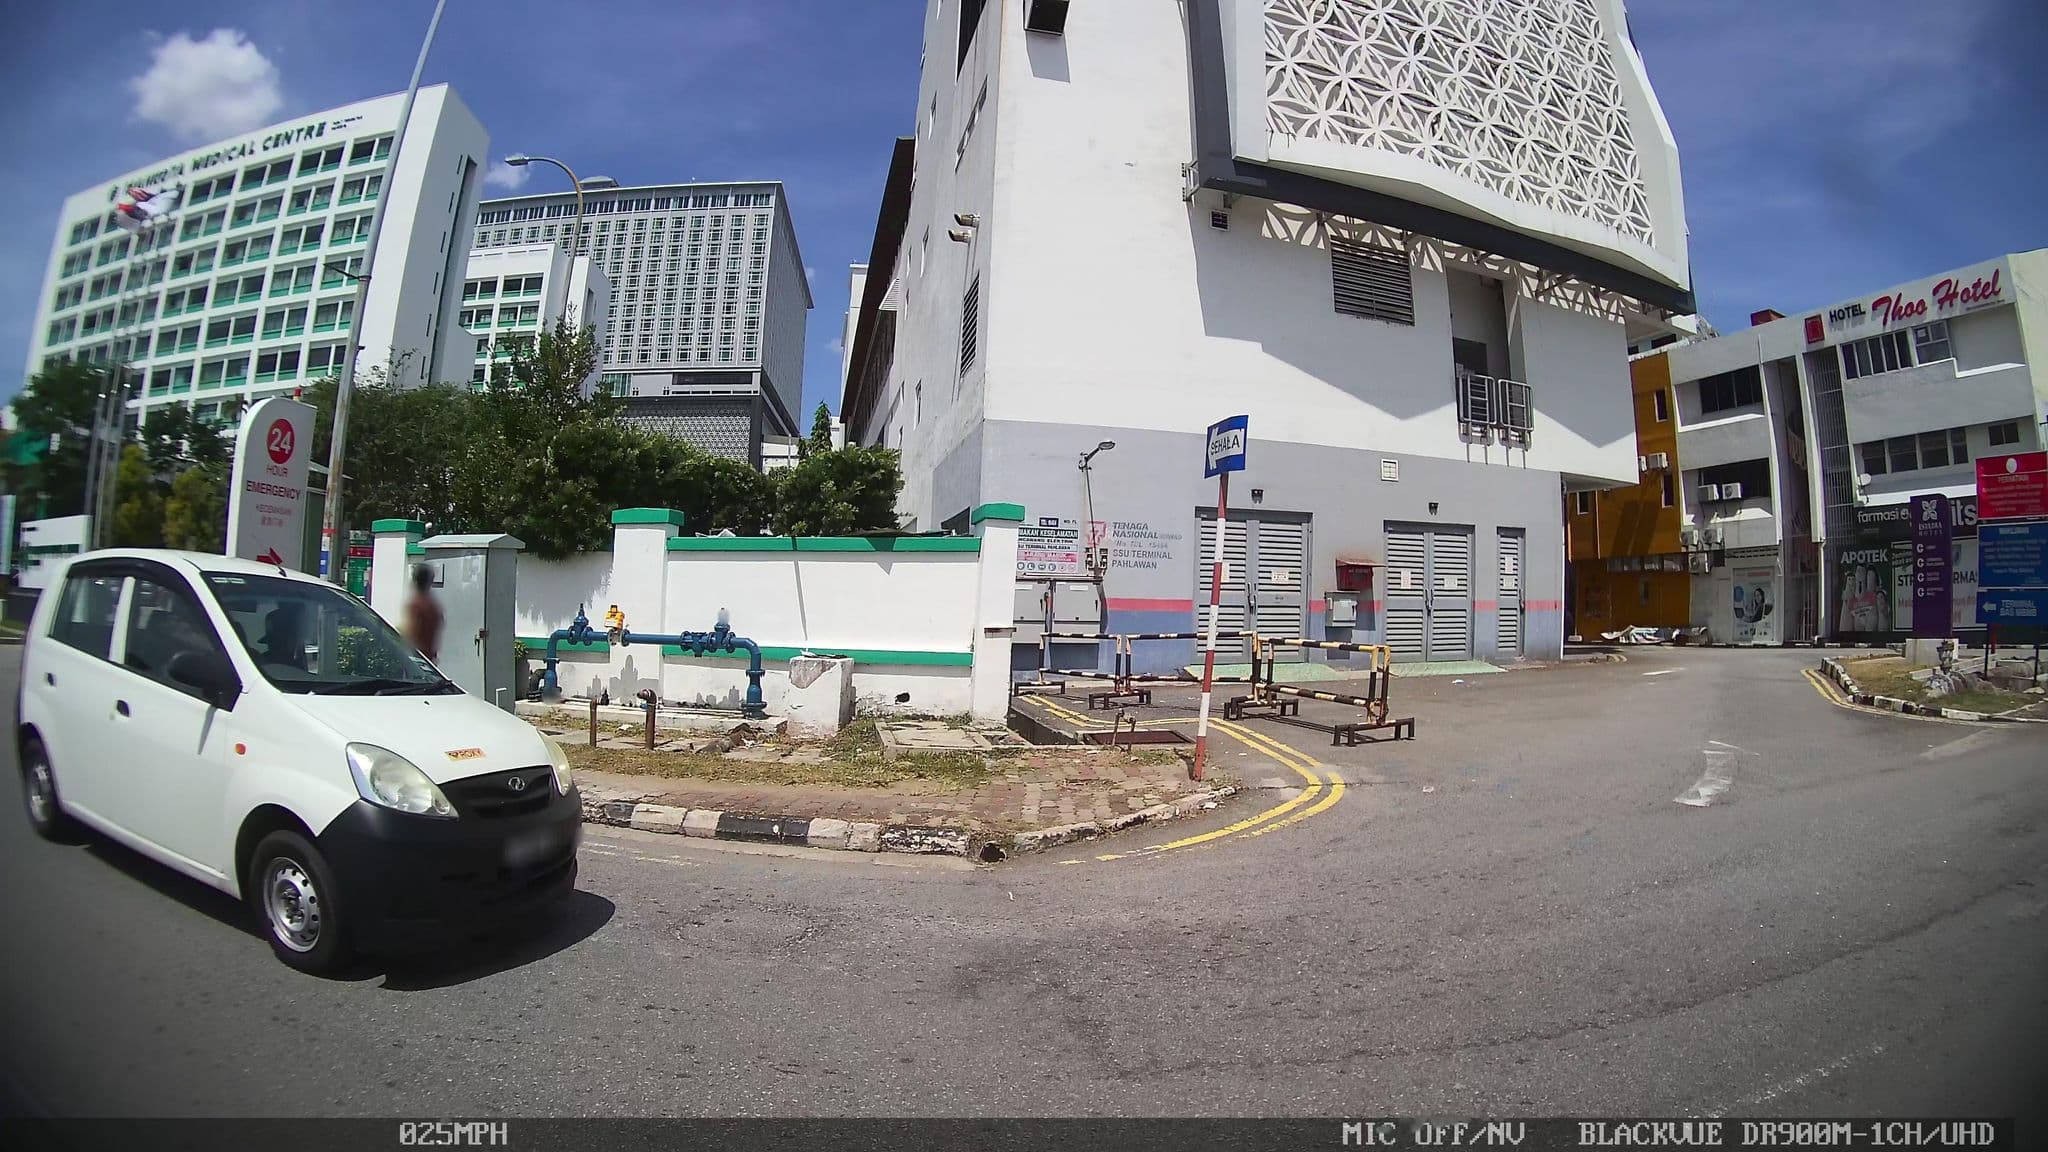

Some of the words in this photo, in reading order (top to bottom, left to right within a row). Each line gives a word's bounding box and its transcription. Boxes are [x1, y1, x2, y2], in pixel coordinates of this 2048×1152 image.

[262, 121, 328, 151] CENTRE
[1828, 303, 1867, 324] HOTEL
[1871, 292, 1929, 327] Thoo
[1932, 268, 2002, 310] Hotel
[270, 427, 292, 454] 24
[266, 464, 288, 478] HOUR
[246, 480, 301, 500] EMERGENCY
[1857, 507, 1900, 524] farmasi
[1950, 499, 1978, 527] its
[1112, 521, 1149, 531] TENAGA
[1112, 530, 1159, 539] NASIONAL
[1112, 549, 1130, 558] SSU
[1131, 549, 1173, 560] TERMINAL
[1840, 548, 1889, 564] APOTEK
[1111, 559, 1158, 569] PAHLAWAN
